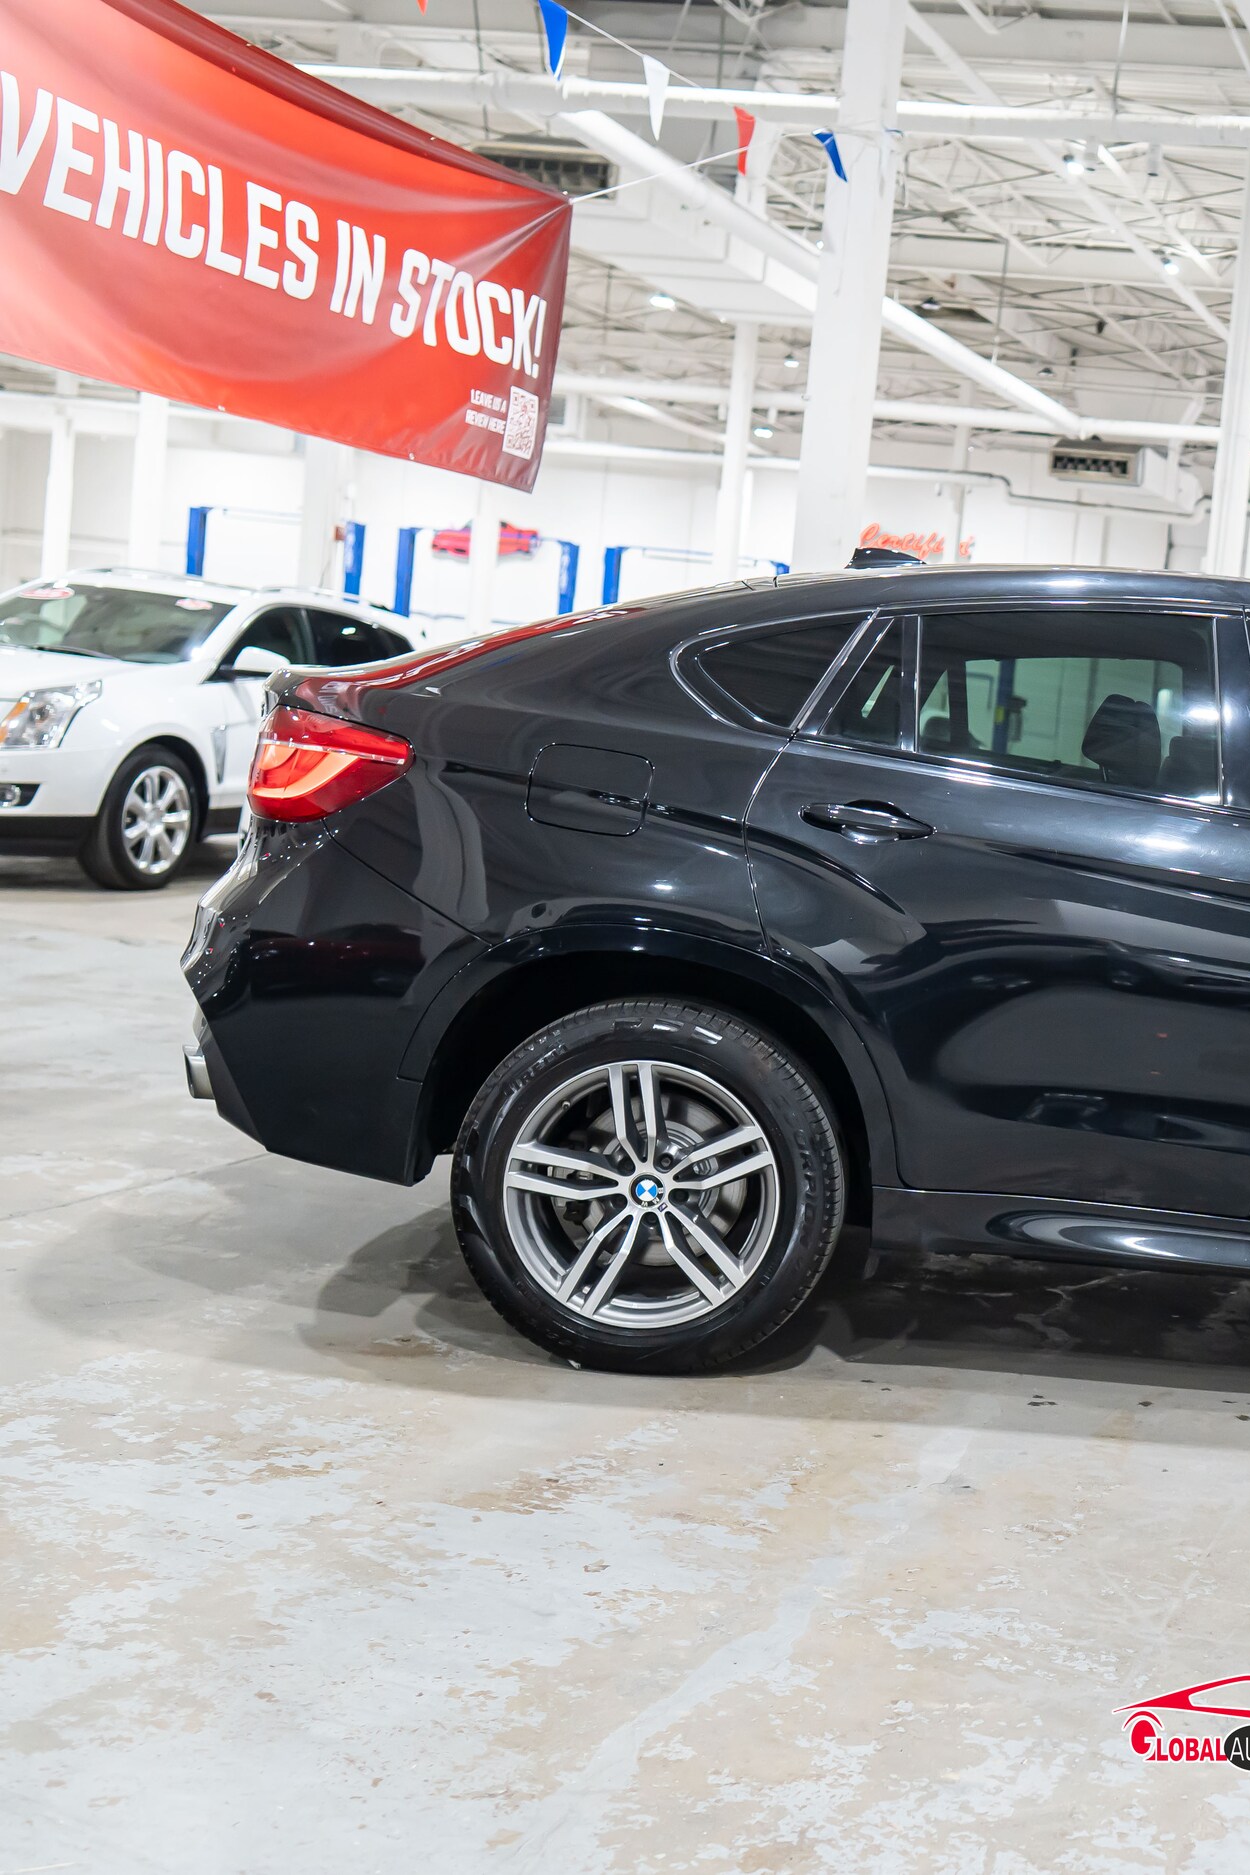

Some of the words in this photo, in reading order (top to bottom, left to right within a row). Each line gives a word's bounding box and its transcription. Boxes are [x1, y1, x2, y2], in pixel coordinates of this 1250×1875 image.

[0, 70, 320, 300] VEHICLES
[329, 218, 387, 326] IN
[389, 247, 548, 380] STOCK!
[859, 522, 975, 560] Certifid
